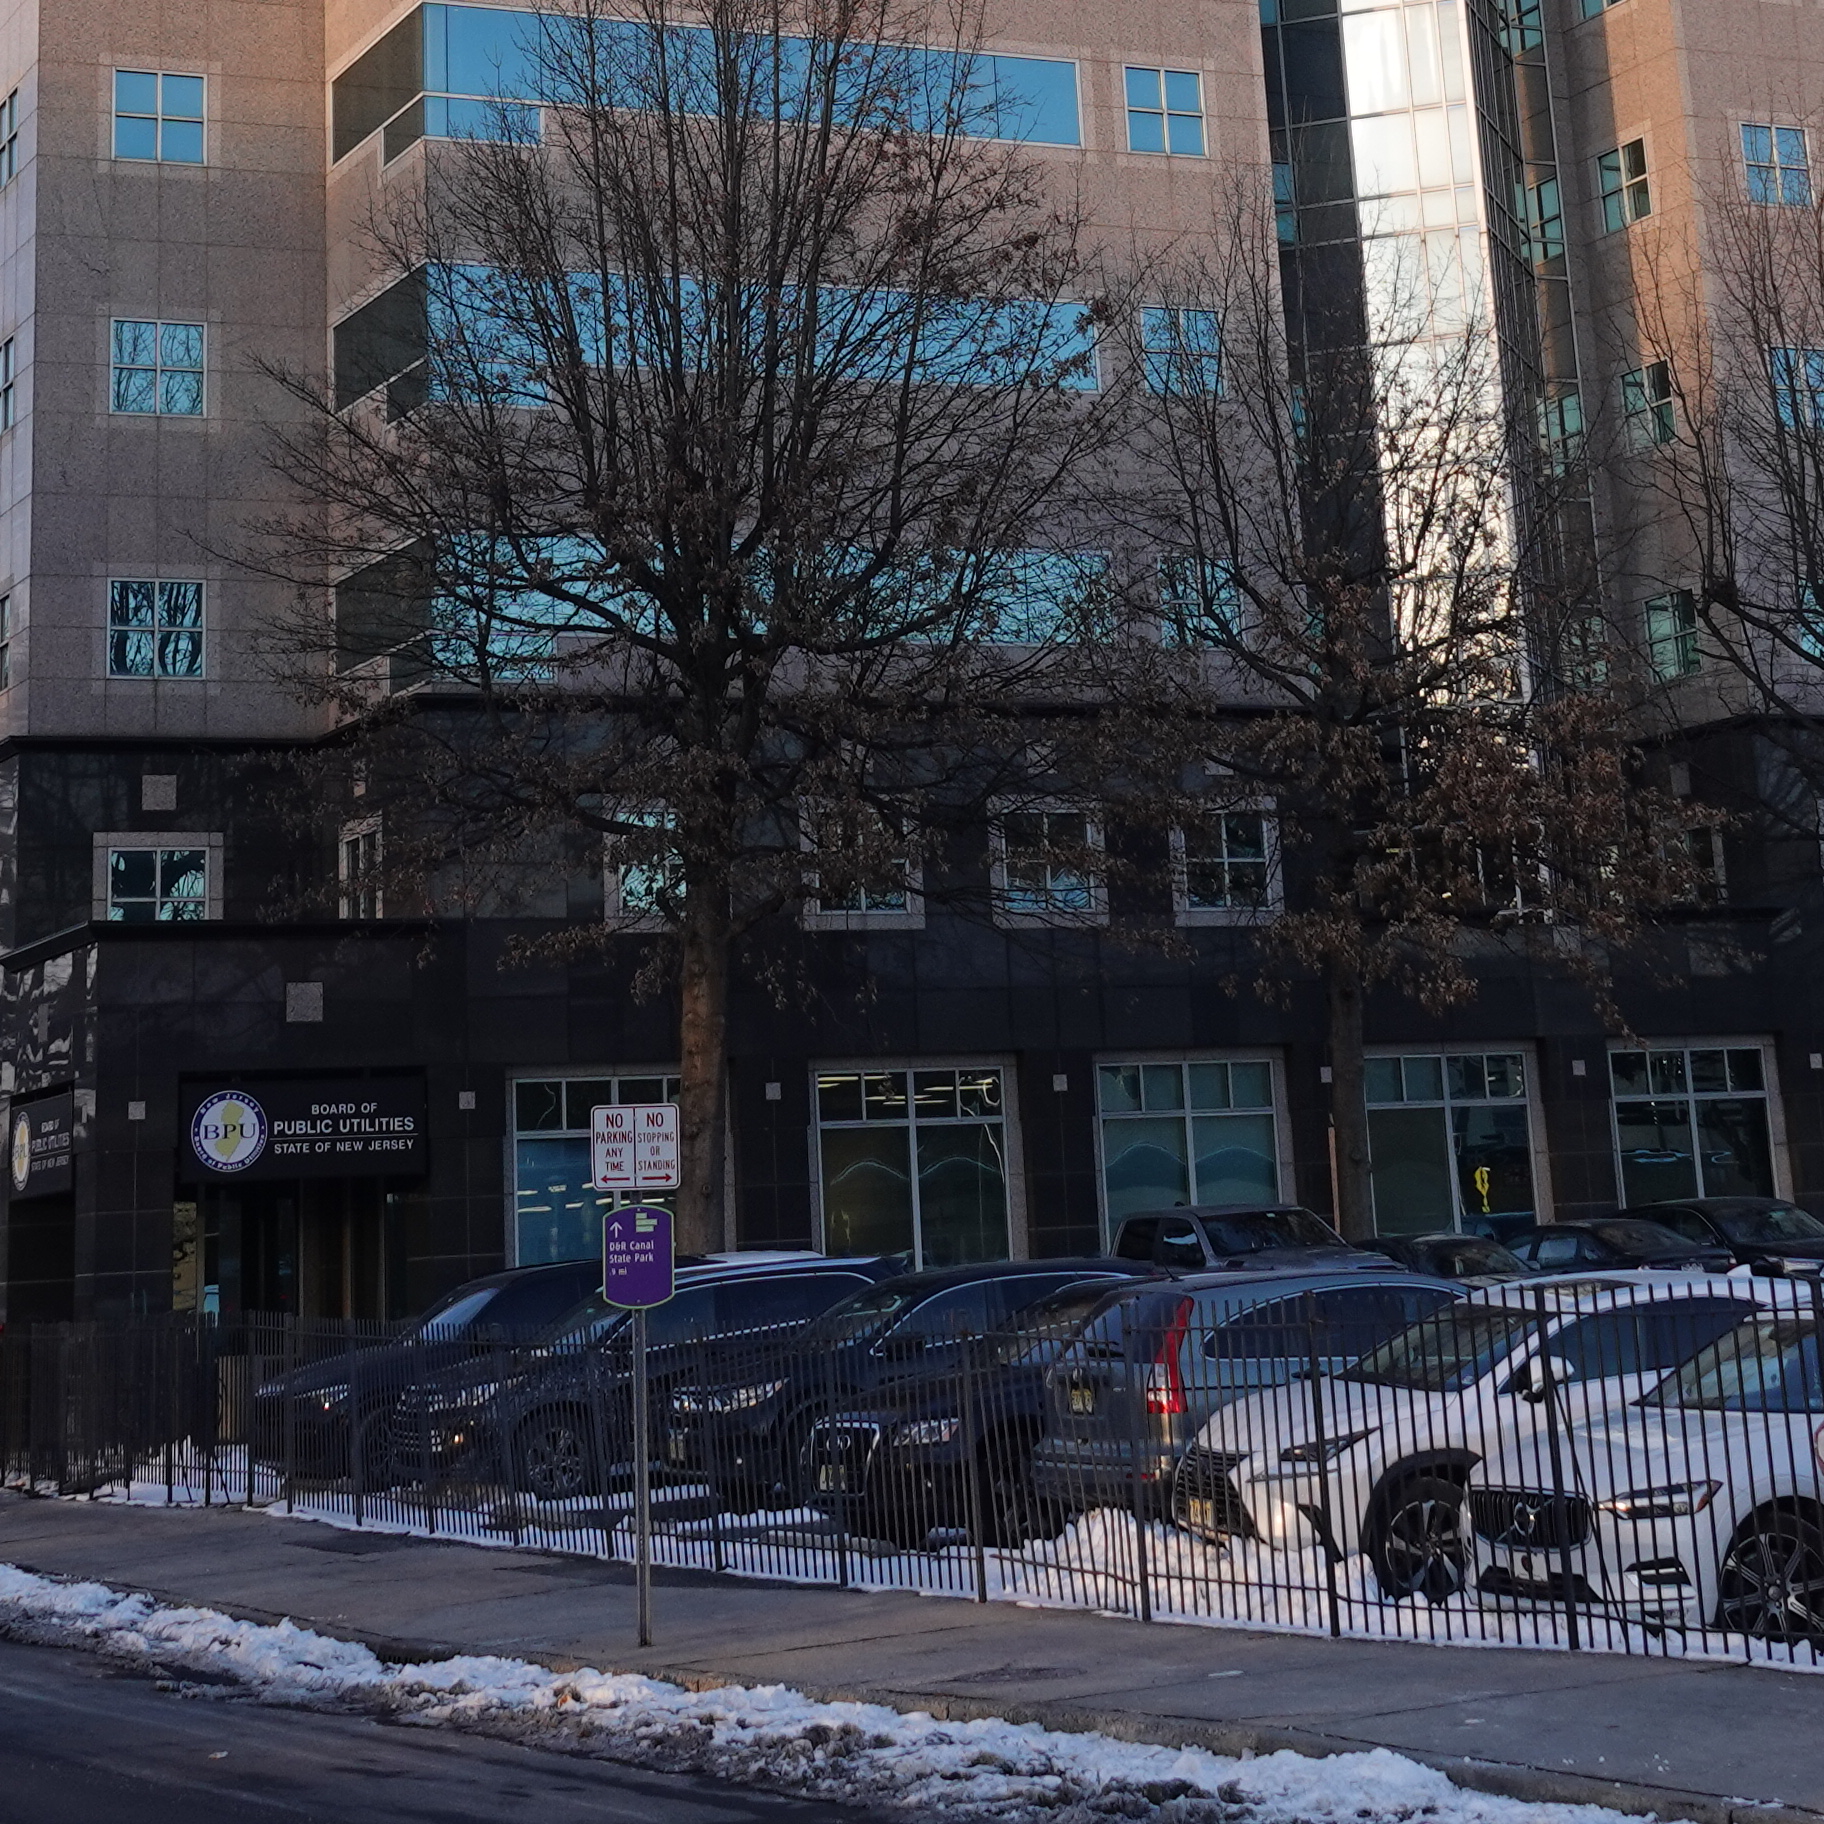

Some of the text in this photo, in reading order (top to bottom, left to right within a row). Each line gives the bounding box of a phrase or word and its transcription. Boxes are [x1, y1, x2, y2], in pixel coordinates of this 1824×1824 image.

[311, 1102, 378, 1115] BOARD OF
[274, 1117, 415, 1135] PUBLIC UTILITIES
[605, 1113, 624, 1129] NO
[646, 1112, 664, 1128] NO
[203, 1123, 256, 1140] BPU
[596, 1131, 633, 1144] PARKING
[637, 1131, 675, 1144] STOPPING
[274, 1139, 415, 1154] STATE OF NEW JERSEY
[605, 1147, 624, 1158] ANY
[650, 1145, 661, 1156] OR
[605, 1161, 625, 1172] TIME
[638, 1159, 676, 1172] STANDING
[609, 1240, 654, 1252] D&R Canal
[609, 1252, 654, 1264] State Park
